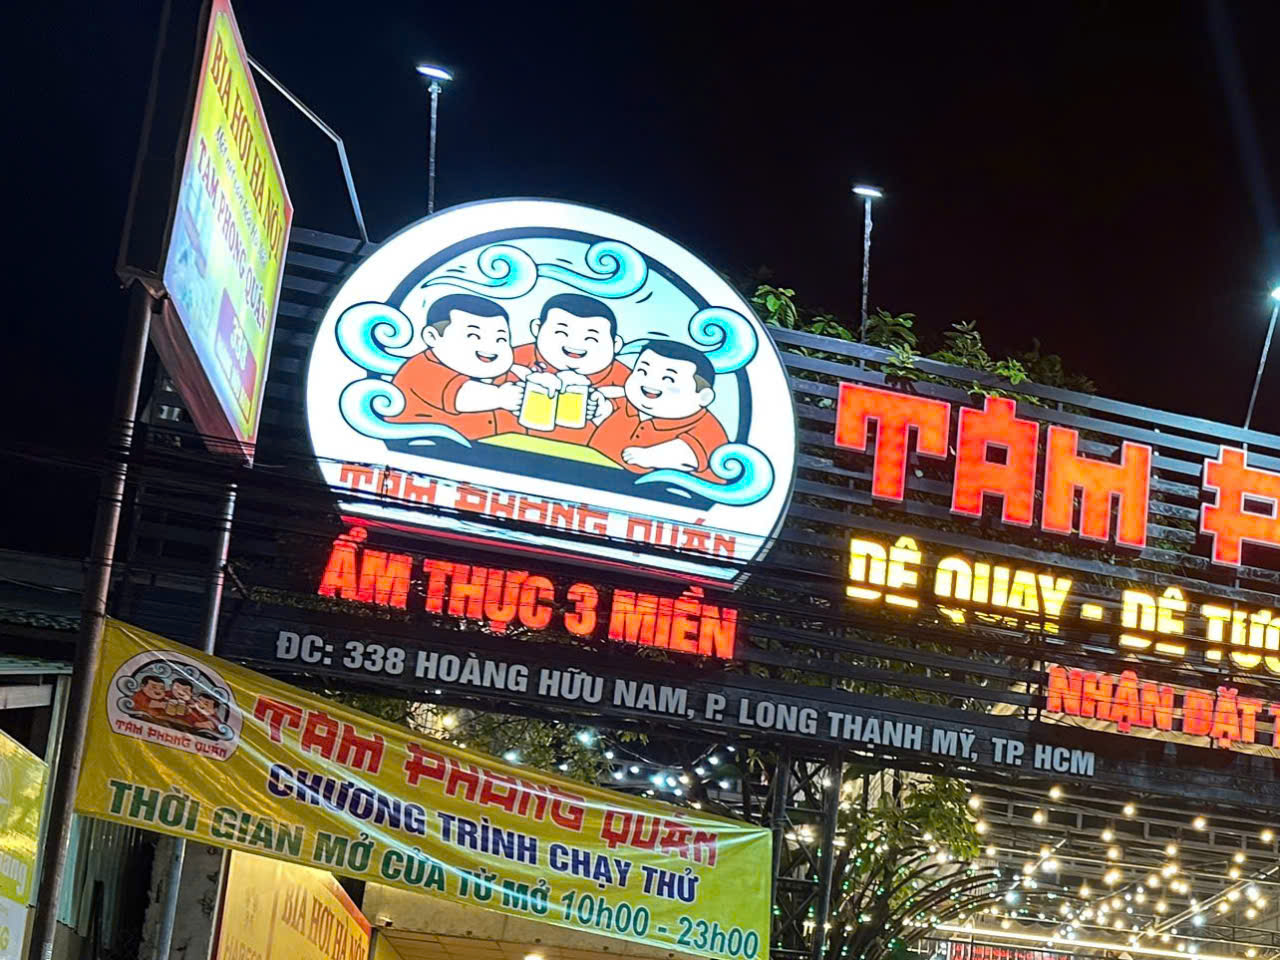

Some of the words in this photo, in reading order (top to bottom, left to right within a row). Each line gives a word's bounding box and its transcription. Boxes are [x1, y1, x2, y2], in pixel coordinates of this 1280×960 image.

[211, 32, 233, 121] BIA
[217, 191, 246, 280] PHONG
[317, 525, 412, 610] ẨM
[423, 557, 556, 636] THỰC
[564, 583, 599, 636] 3
[609, 585, 740, 660] MIỀN
[846, 536, 922, 608] DÊ
[934, 556, 1072, 634] QUAY
[1119, 586, 1189, 656] DÊ
[275, 630, 334, 667] ĐC:
[343, 640, 405, 676] 338
[414, 650, 529, 692] HOÀNG
[538, 666, 604, 704] HỮU
[613, 679, 694, 721] NAM,
[739, 699, 819, 735] LONG
[931, 726, 980, 764] MỸ,
[992, 736, 1023, 766] TP.
[1033, 749, 1095, 777] HCM
[1046, 664, 1175, 734] NHẬN
[1182, 685, 1262, 749] ĐẶT
[267, 763, 427, 835] CHƯƠNG
[437, 811, 538, 866] TRÌNH
[549, 843, 632, 890] CHẠY
[641, 867, 700, 903] THỬ
[403, 741, 586, 832] PHONG
[601, 808, 718, 868] QUÁN
[107, 779, 200, 829] THỜI
[210, 808, 304, 858] GIAN
[312, 830, 375, 878] MỞ
[456, 866, 498, 902] TỪ
[501, 877, 551, 916] MỞ
[560, 889, 650, 938] 10h00
[676, 915, 760, 960] 23h00
[281, 887, 309, 937] BIA
